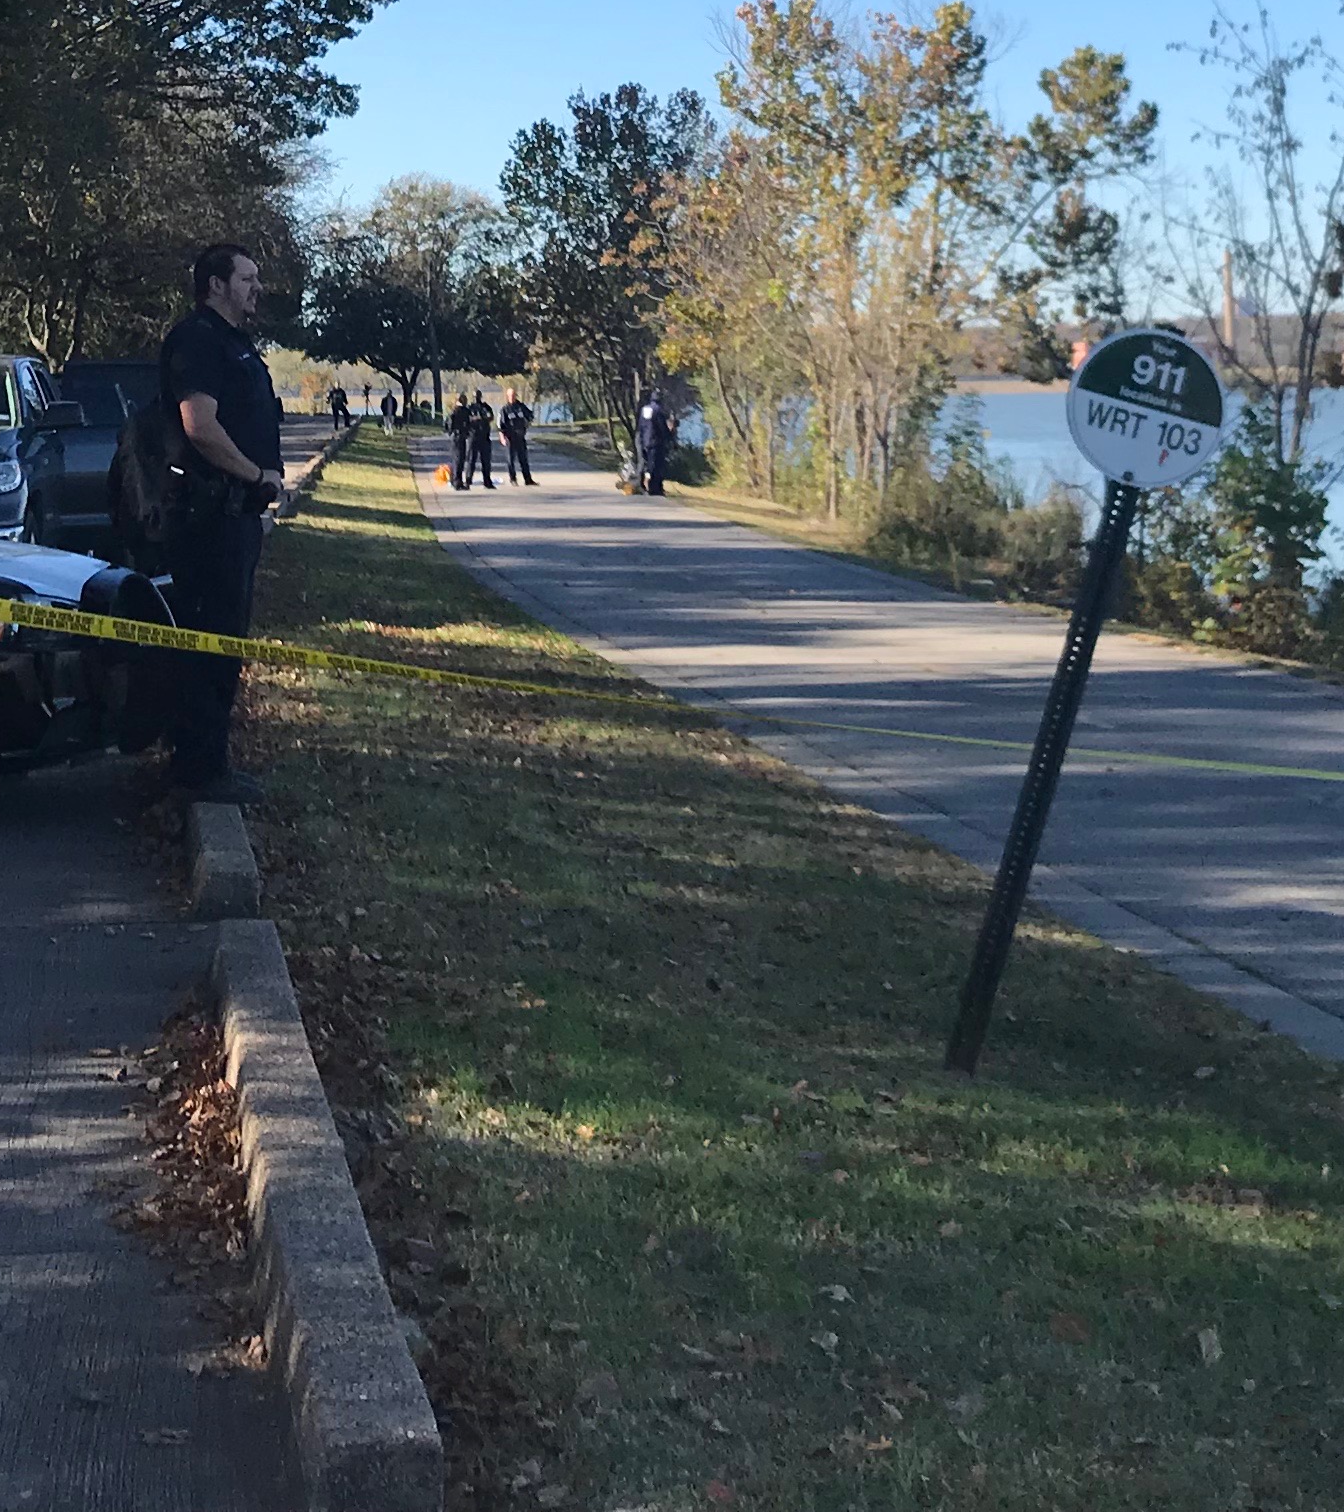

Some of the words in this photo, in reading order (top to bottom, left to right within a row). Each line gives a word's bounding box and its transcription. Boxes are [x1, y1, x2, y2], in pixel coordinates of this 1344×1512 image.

[1131, 354, 1187, 395] 911
[1087, 399, 1148, 439] WRT
[1157, 420, 1202, 455] 103
